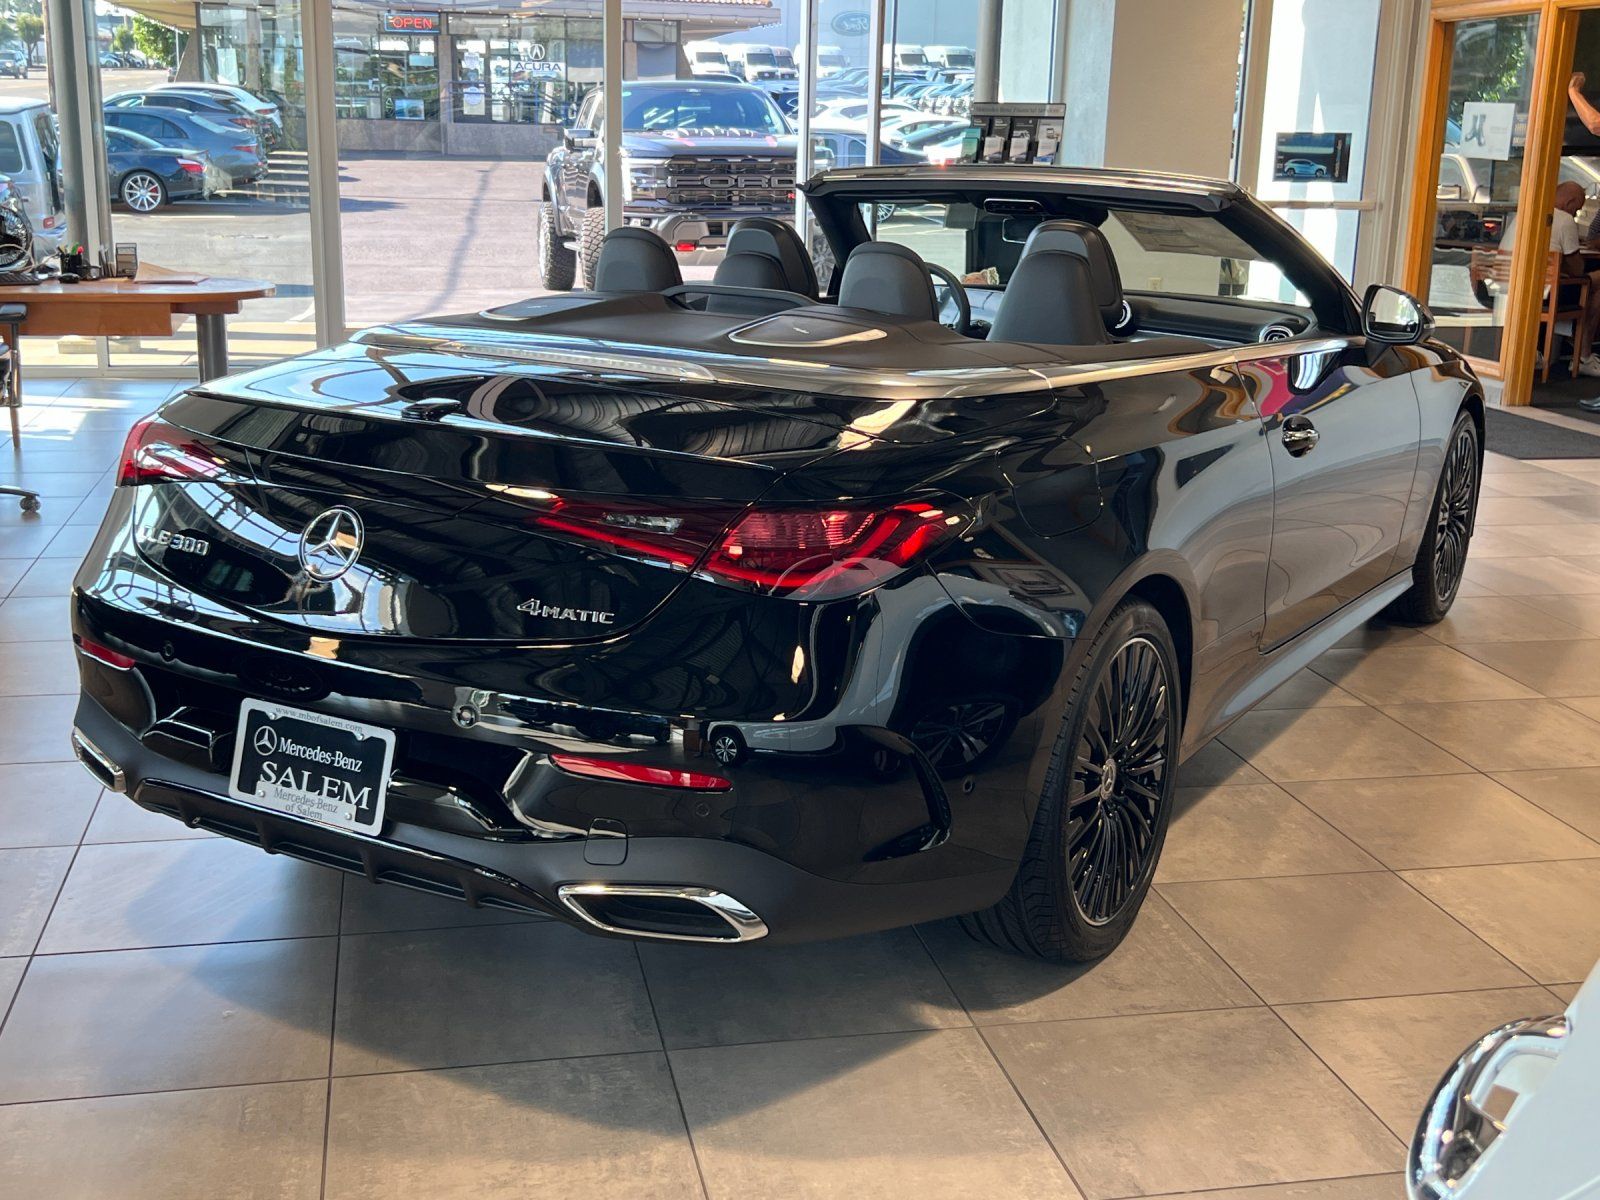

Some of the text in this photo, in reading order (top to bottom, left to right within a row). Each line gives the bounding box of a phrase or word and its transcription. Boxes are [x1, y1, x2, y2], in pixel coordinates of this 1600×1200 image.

[393, 17, 432, 29] OPEN
[515, 62, 562, 72] ACURA
[667, 175, 796, 188] FORD
[517, 598, 615, 624] 4MATIC
[275, 707, 363, 733] www.mbofsalem.com
[278, 737, 363, 773] Mercedes-Benz
[260, 761, 372, 810] SALEM
[273, 787, 338, 814] Mercedes-Benz
[285, 803, 323, 820] of Salem
